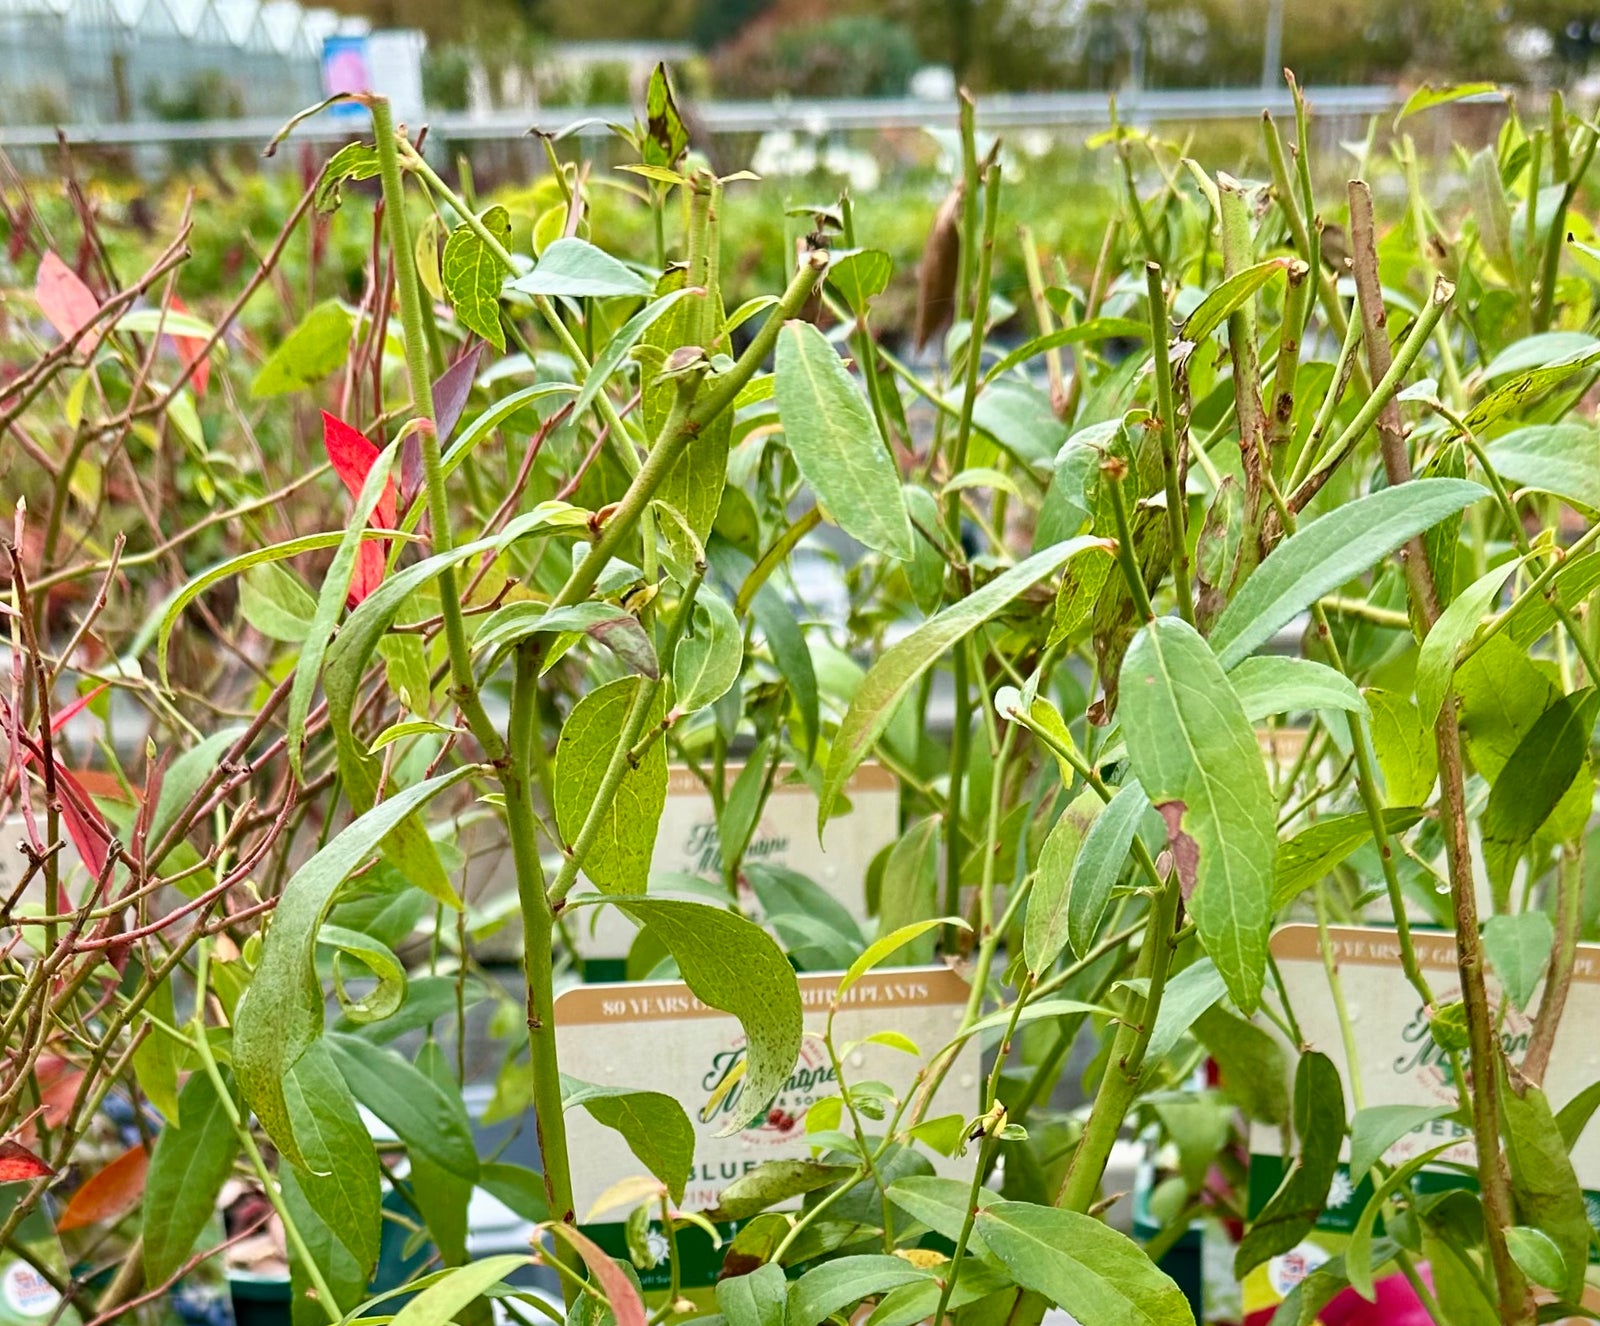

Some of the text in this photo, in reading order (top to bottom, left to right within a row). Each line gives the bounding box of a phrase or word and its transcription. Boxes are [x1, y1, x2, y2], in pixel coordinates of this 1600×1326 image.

[602, 1000, 626, 1016] 80
[630, 996, 689, 1015] YEARS
[860, 983, 928, 1002] PLANTS
